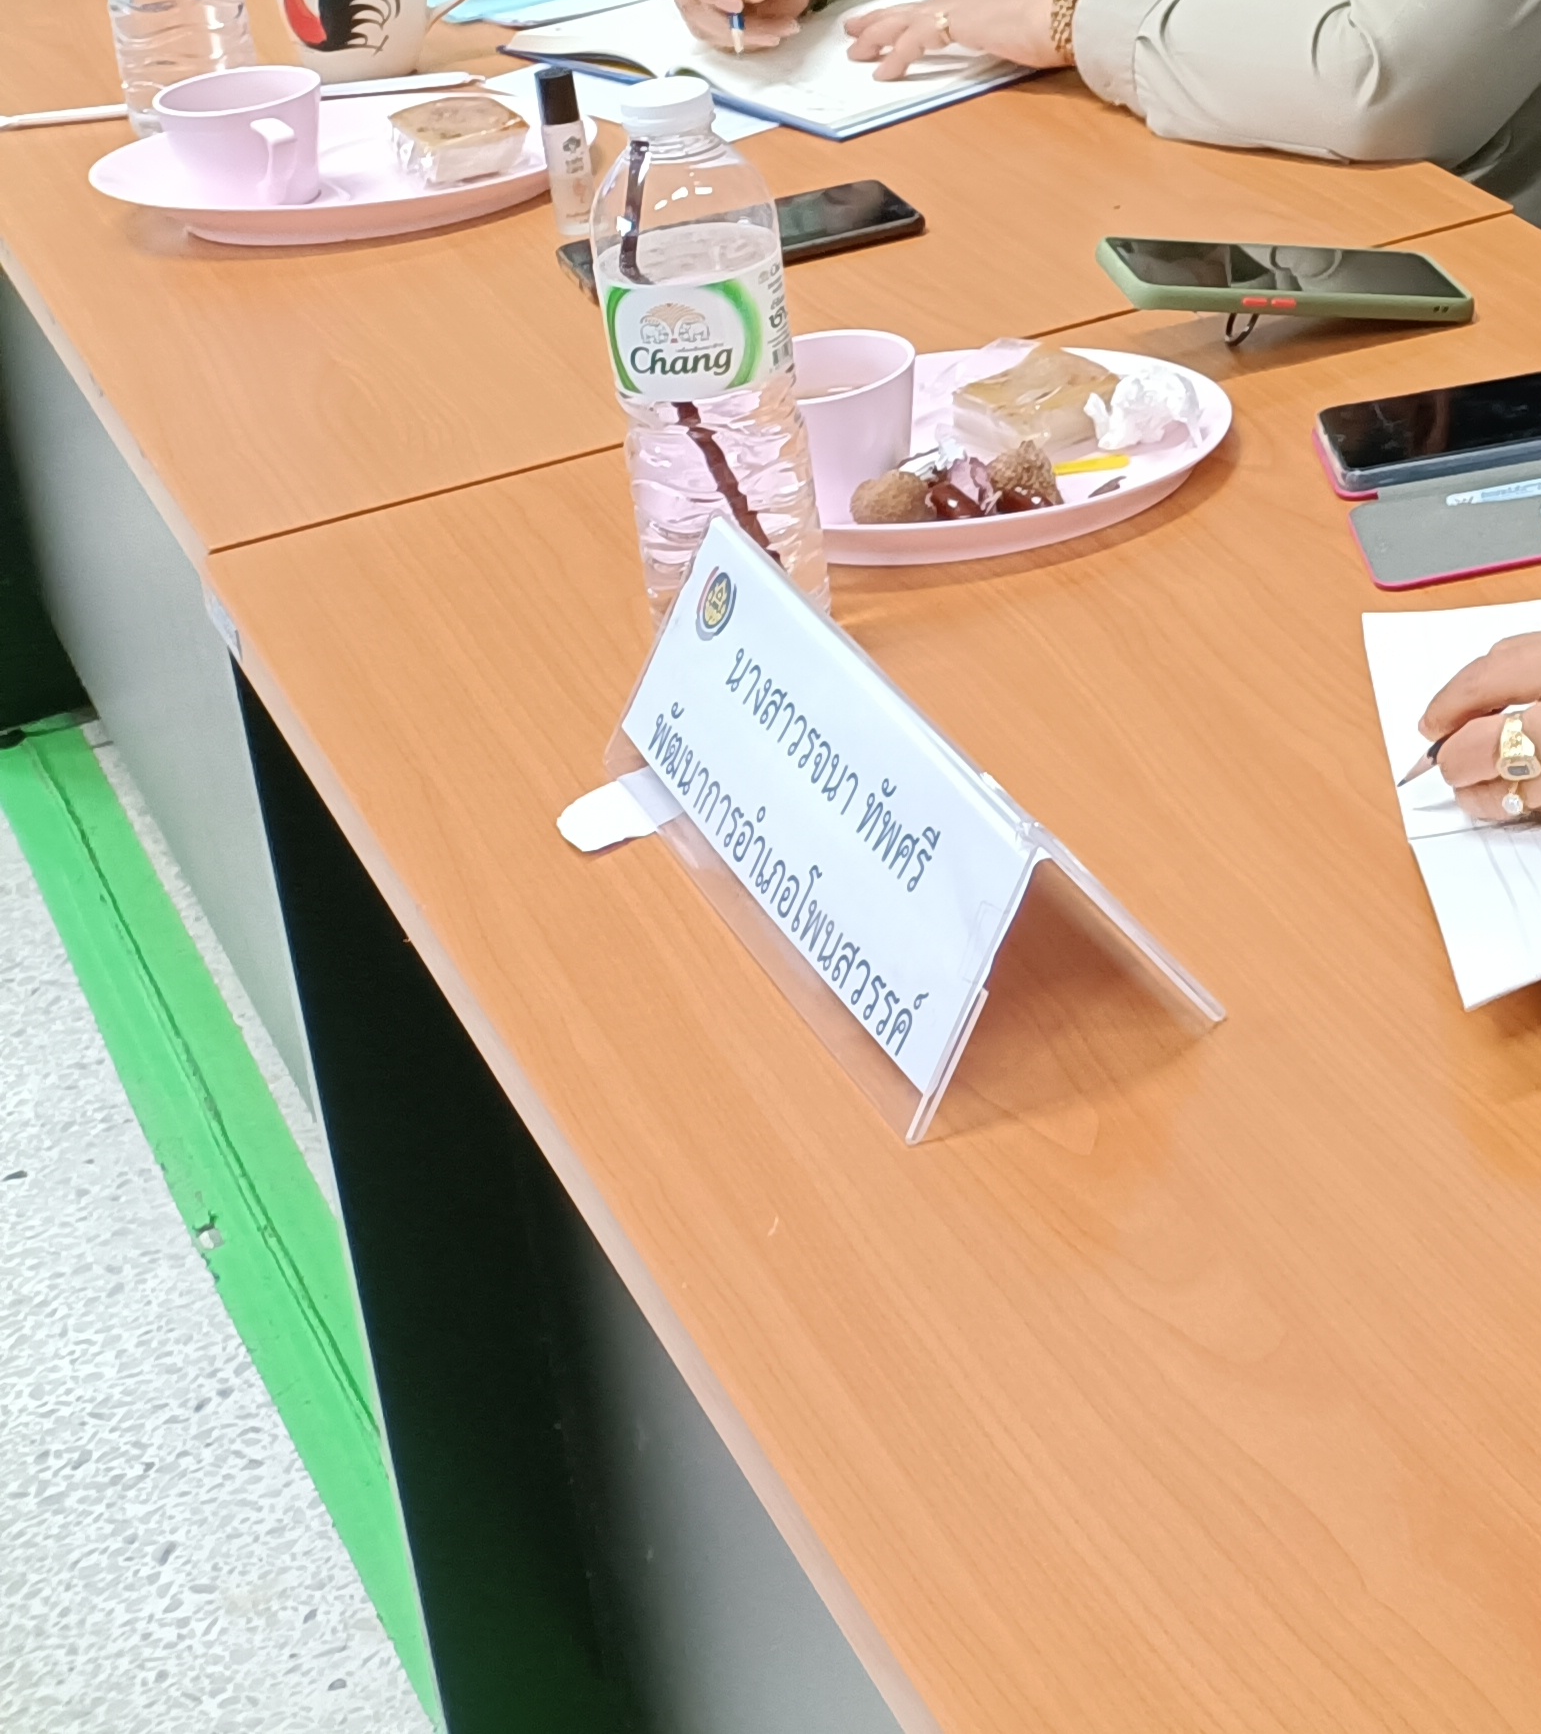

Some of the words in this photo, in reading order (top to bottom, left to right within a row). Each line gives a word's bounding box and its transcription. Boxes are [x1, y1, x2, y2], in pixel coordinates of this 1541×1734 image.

[630, 346, 733, 376] Chang
[648, 702, 929, 1057] พัฒนาการอำเภอโพนสวรรค์
[726, 647, 859, 816] นางสาวรจนา
[856, 778, 941, 893] ทัพศรี
